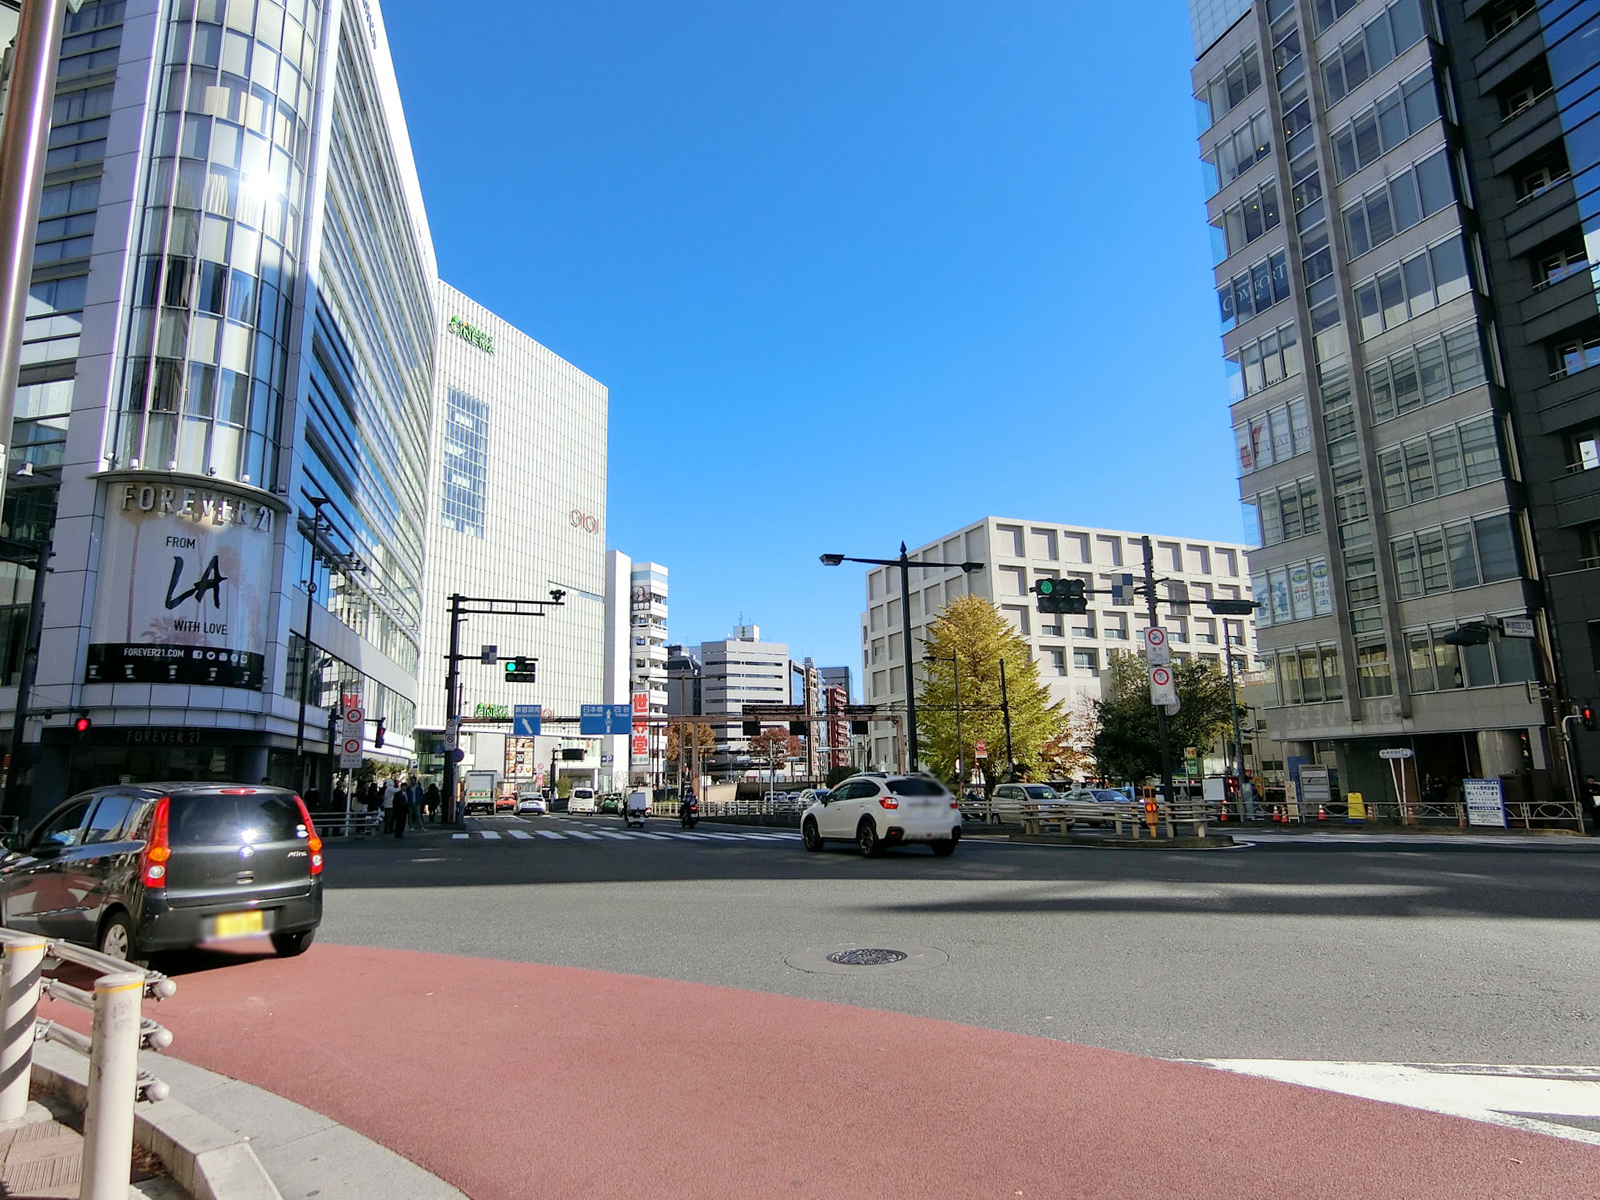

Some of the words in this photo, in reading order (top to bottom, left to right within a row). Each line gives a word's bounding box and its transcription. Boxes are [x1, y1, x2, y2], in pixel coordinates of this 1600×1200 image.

[448, 321, 495, 357] CINEMA
[121, 483, 248, 525] FOREVER
[256, 504, 275, 533] 21
[166, 536, 196, 549] FROM
[165, 555, 228, 610] LA
[174, 620, 200, 632] WITH
[124, 648, 184, 658] FOREVER21.COM
[127, 730, 183, 743] FOREVER
[189, 731, 200, 743] 21
